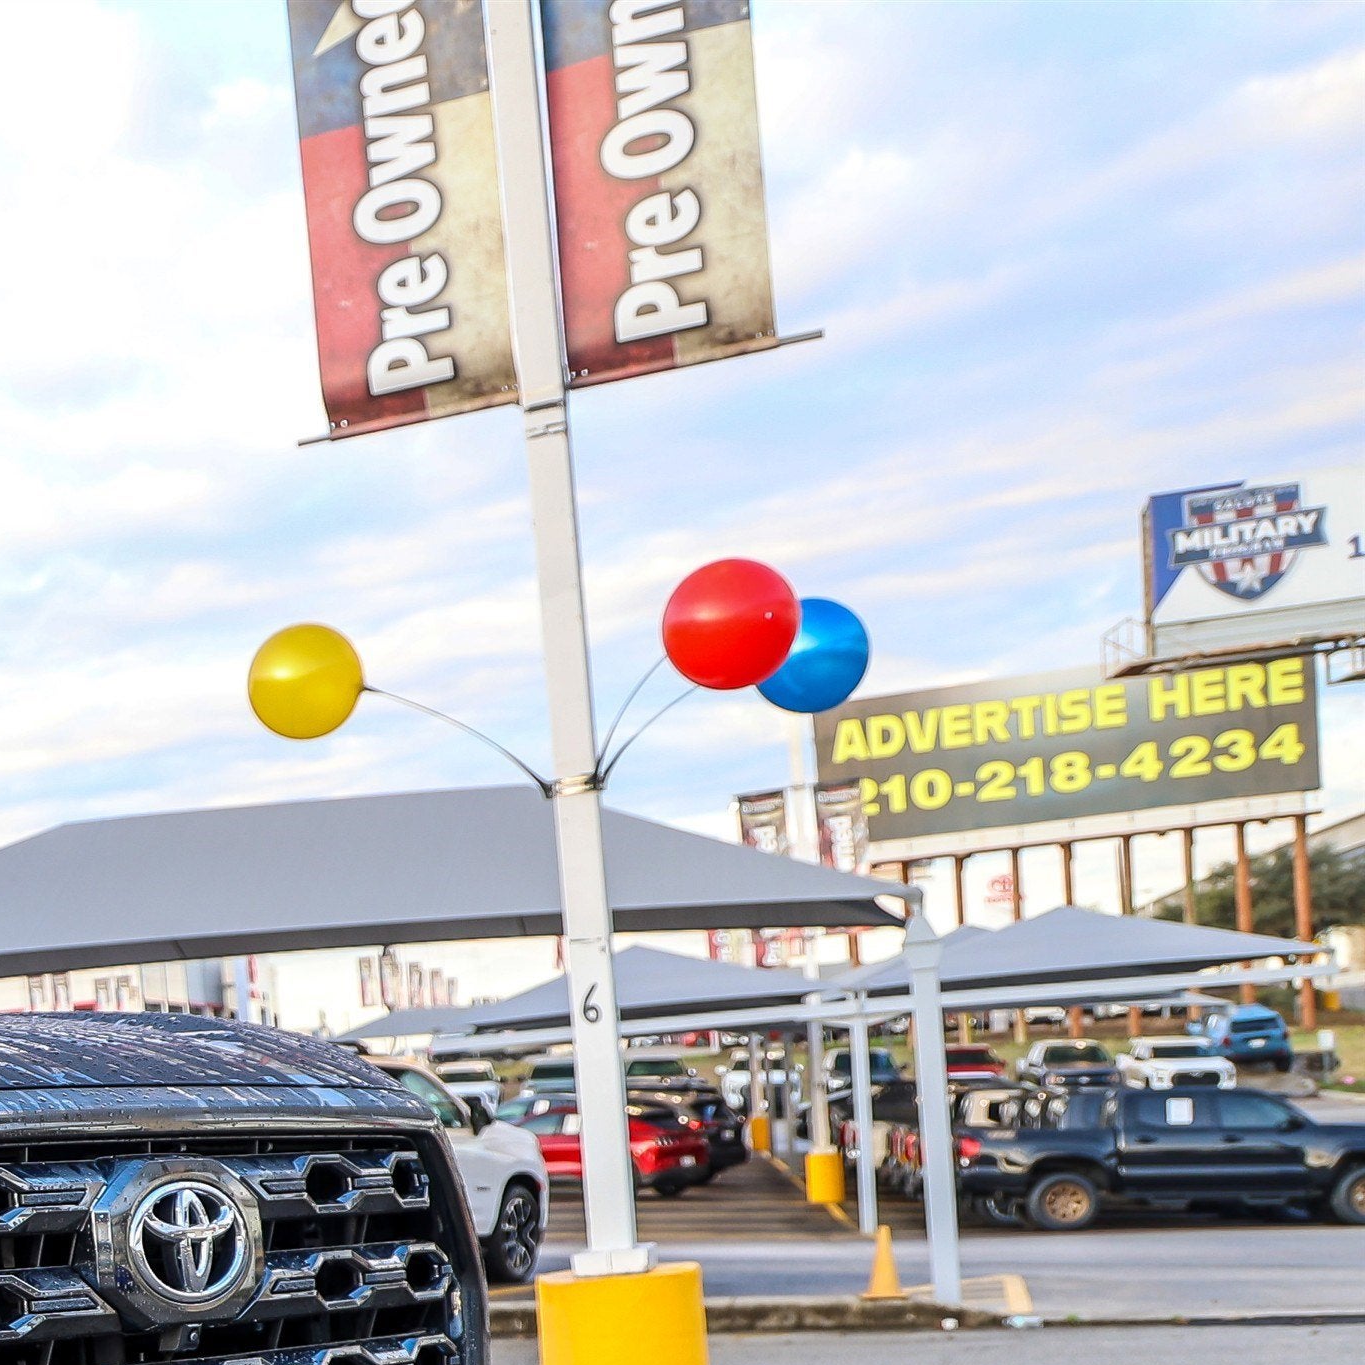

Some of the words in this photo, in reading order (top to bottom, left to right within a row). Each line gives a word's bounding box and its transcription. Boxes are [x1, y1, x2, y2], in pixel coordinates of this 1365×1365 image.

[613, 188, 708, 344] Pre
[367, 254, 456, 396] Pre
[1174, 510, 1318, 554] MILITARY
[832, 683, 1128, 764] ADVERTISE
[1148, 656, 1305, 722] HERE
[582, 982, 601, 1023] 6
